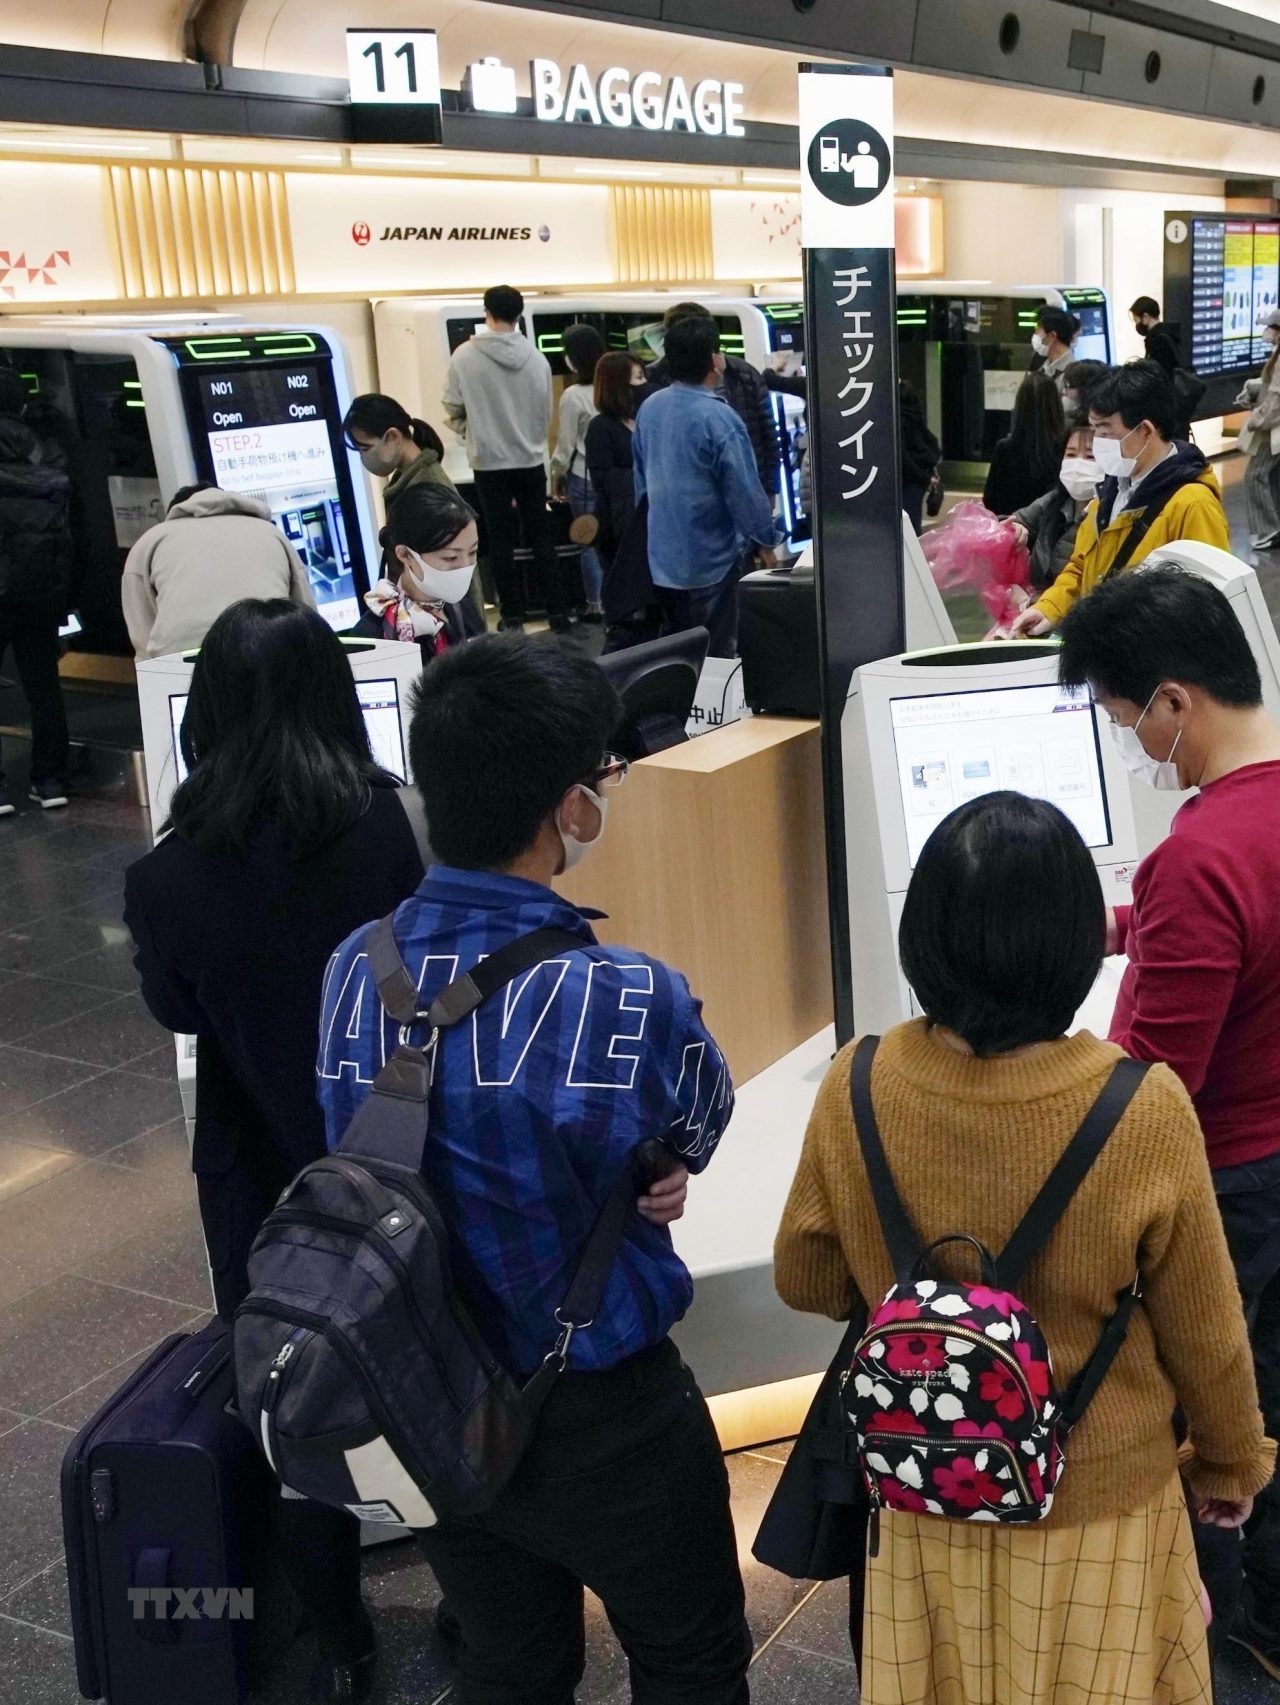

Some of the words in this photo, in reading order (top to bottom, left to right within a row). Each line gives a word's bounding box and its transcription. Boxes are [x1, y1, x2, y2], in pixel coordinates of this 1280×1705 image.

[362, 42, 417, 93] 11
[532, 58, 746, 136] BAGGAGE
[380, 227, 443, 241] JAPAN
[447, 227, 532, 241] AIRLINES
[210, 381, 234, 396] N01
[287, 374, 309, 389] N02
[832, 266, 879, 500] チェックイン
[212, 411, 243, 427] Open
[288, 404, 317, 419] Open
[213, 433, 263, 454] STEP.2
[899, 1367, 922, 1378] kate
